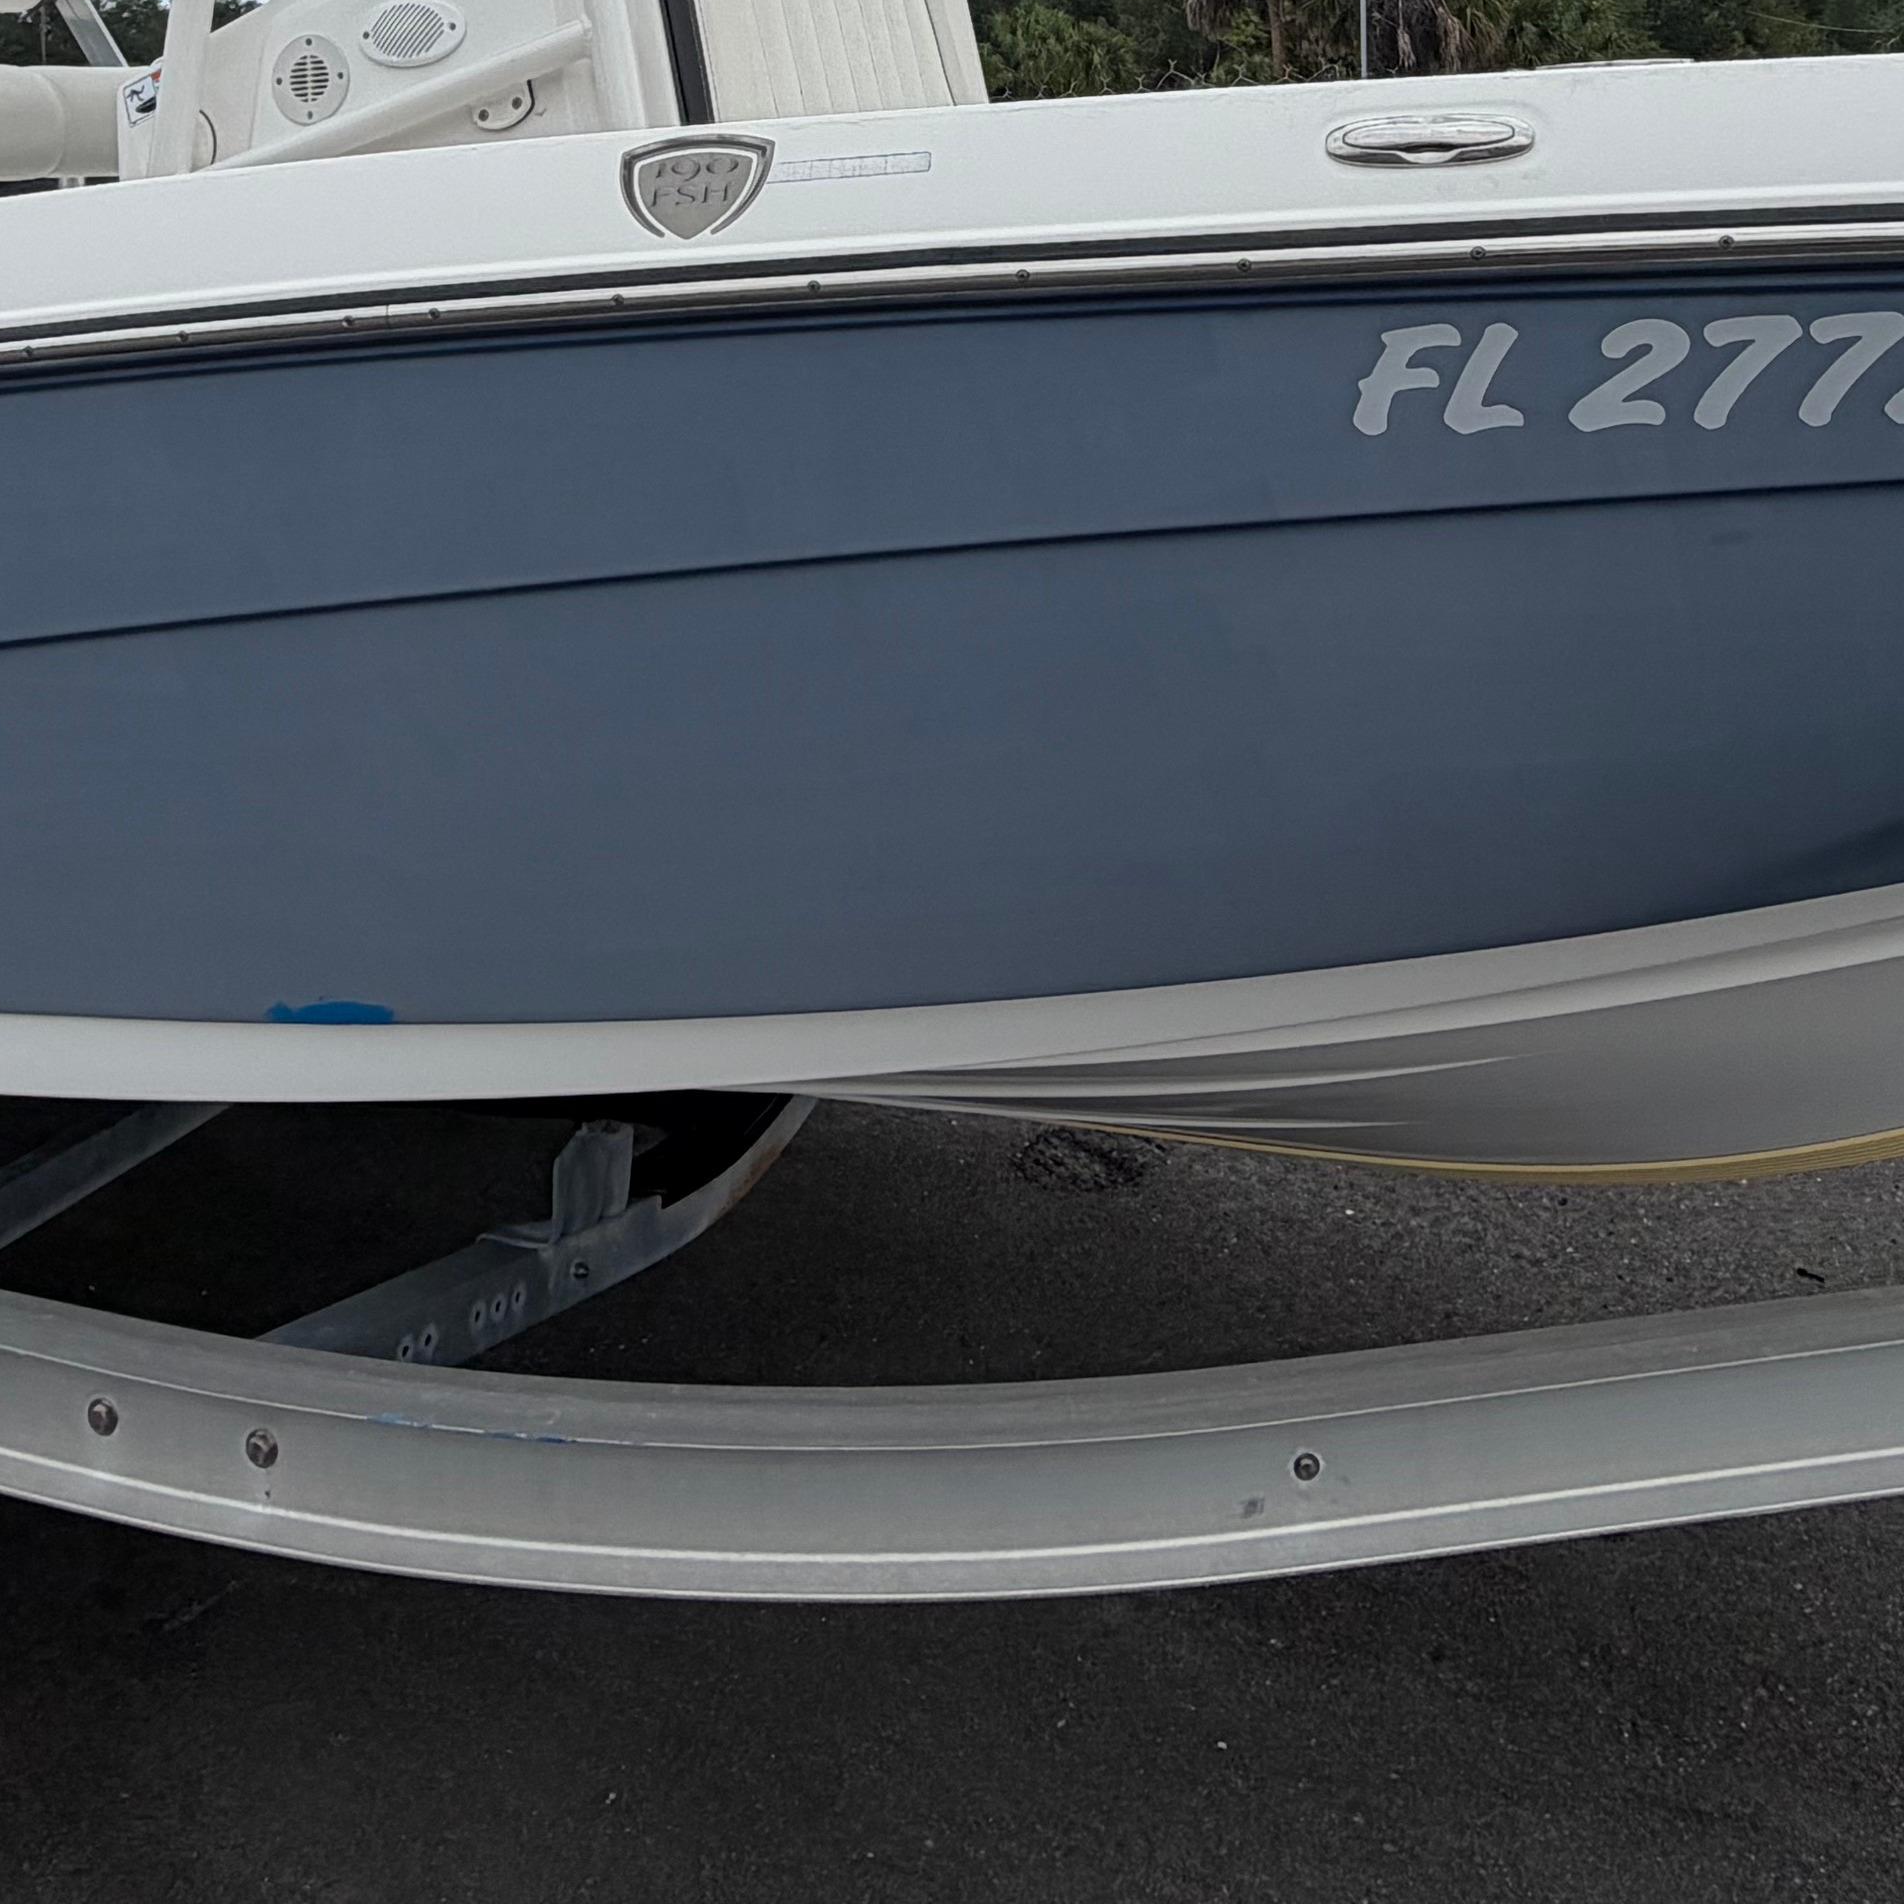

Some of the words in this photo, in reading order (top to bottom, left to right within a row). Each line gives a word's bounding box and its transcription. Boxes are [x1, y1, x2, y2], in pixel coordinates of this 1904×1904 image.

[655, 156, 739, 182] 190
[649, 182, 730, 209] FSH
[1352, 321, 1525, 436] FL
